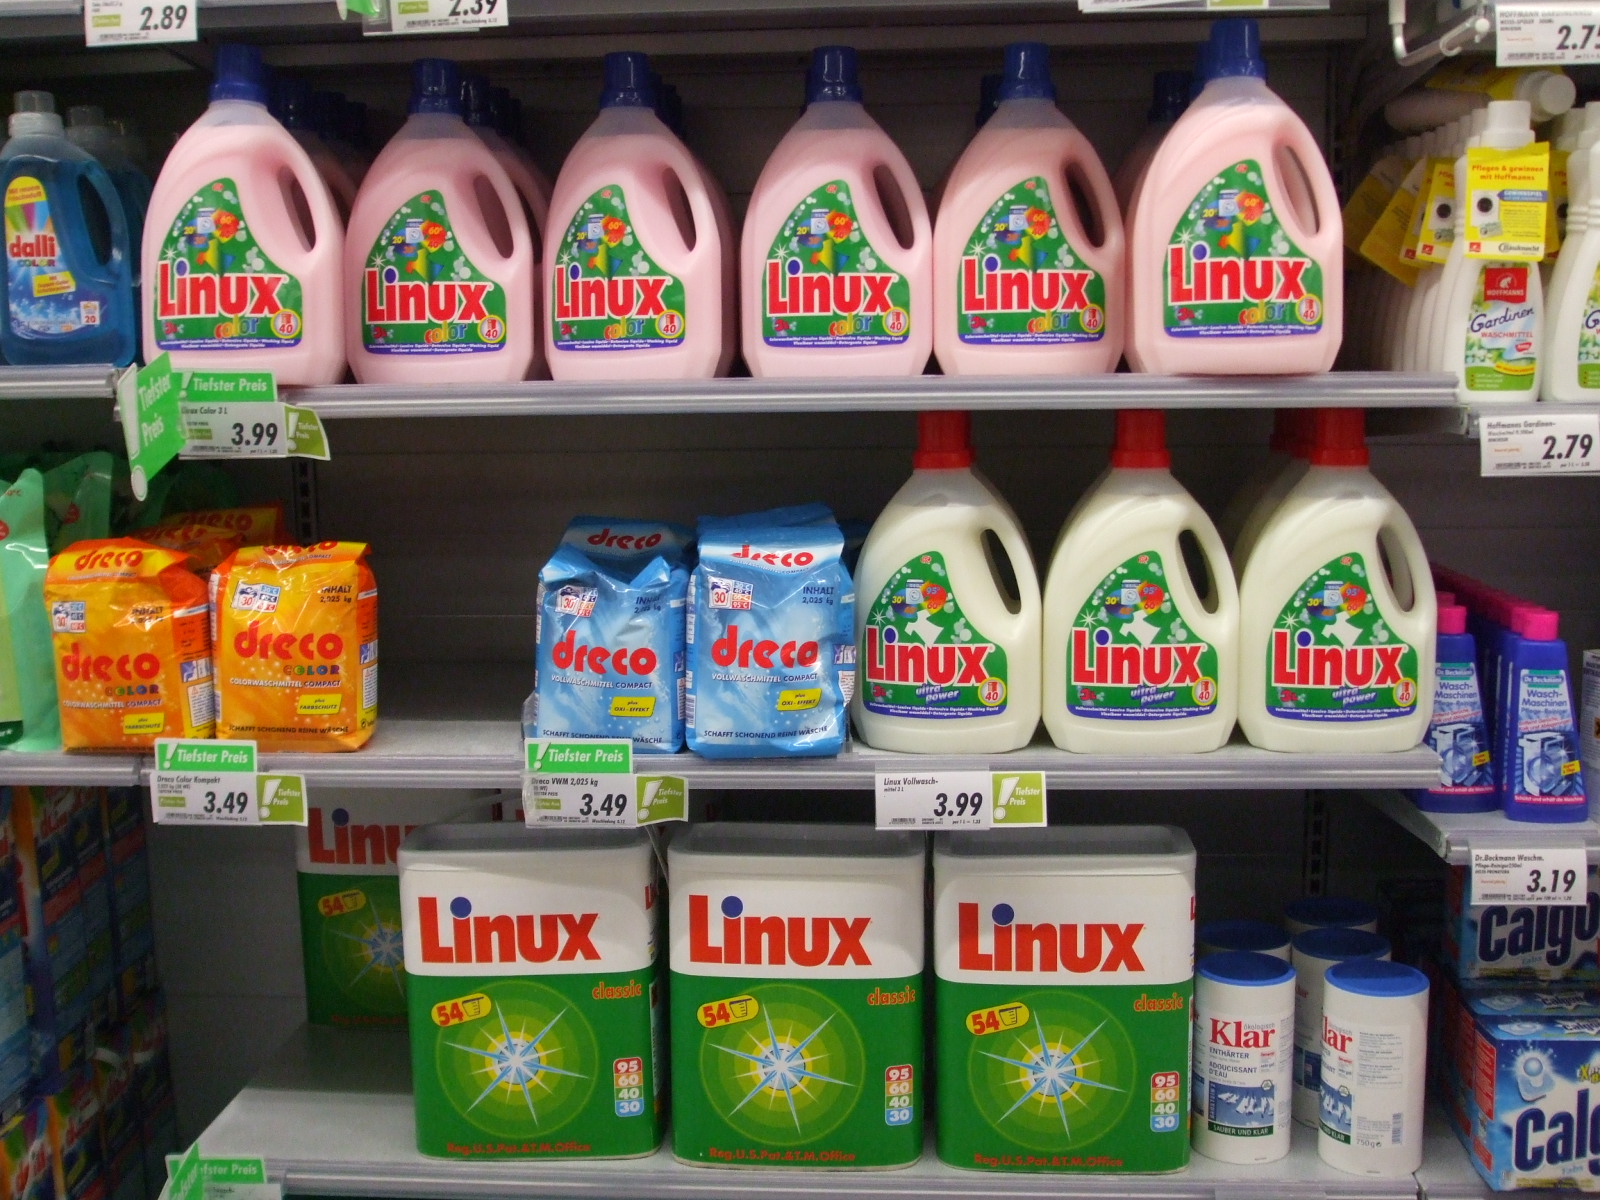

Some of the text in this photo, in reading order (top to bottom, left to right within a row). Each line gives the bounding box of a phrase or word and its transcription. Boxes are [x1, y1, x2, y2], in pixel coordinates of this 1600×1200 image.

[139, 5, 188, 31] 2.89
[1472, 165, 1499, 173] Pflegen
[9, 234, 56, 258] dalli
[17, 259, 56, 267] COLOR
[1170, 243, 1307, 303] Linux
[159, 259, 285, 318] Linux
[768, 259, 894, 315] Linux
[963, 256, 1090, 312] Linux
[367, 267, 490, 323] Linux
[556, 263, 668, 319] Linux
[1238, 300, 1285, 325] color
[1303, 311, 1315, 320] 40
[85, 316, 96, 324] 20
[214, 314, 260, 339] color
[829, 312, 873, 336] color
[889, 322, 902, 331] 40
[1027, 309, 1070, 333] color
[1087, 319, 1098, 328] 40
[1470, 307, 1535, 333] Gardinen
[279, 324, 293, 333] 40
[424, 320, 467, 344] color
[485, 329, 498, 339] 40
[604, 316, 645, 340] color
[663, 324, 677, 333] 40
[193, 377, 267, 392] Tiefster Preis
[138, 374, 171, 411] Tiefster
[142, 414, 164, 446] Preis
[231, 422, 278, 446] 3.99
[1542, 434, 1593, 460] 2.79
[587, 528, 662, 550] dreco
[74, 550, 143, 571] dreco
[730, 545, 813, 567] dreco
[714, 592, 726, 603] 30
[803, 587, 834, 595] INHALT
[241, 597, 252, 606] 30
[826, 597, 834, 605] kg
[234, 620, 344, 660] dreco
[711, 625, 819, 668] dreco
[552, 629, 657, 676] dreco
[866, 627, 990, 685] Linux
[1073, 629, 1203, 685] Linux
[1274, 630, 1404, 687] Linux
[62, 642, 160, 681] dreco
[283, 665, 340, 675] COLOR
[230, 678, 341, 688] COLORWASCHMITTEL COMPACT
[551, 675, 614, 689] VOLLWASCHMITTEL
[711, 673, 818, 683] VOLLWASCHMITTEL COMPACT
[105, 684, 159, 696] COLOR
[915, 684, 941, 696] ultra
[1130, 685, 1158, 697] ultra
[1332, 686, 1359, 698] ultra
[1439, 682, 1472, 690] Wasch-
[925, 689, 960, 703] power
[985, 691, 998, 700] 40
[1140, 690, 1175, 703] power
[1199, 692, 1210, 700] 40
[1342, 691, 1376, 705] power
[1399, 692, 1411, 701] 40
[1435, 691, 1477, 699] Maschinen
[1527, 690, 1563, 698] Wasch-
[63, 699, 162, 709] COLORWASCHMITTEL COMPACT
[1522, 698, 1567, 706] Maschinen
[257, 726, 297, 734] SCHONEND
[543, 730, 569, 738] SCHAFFT
[704, 726, 828, 739] SCHAFFT SCHONEND REINE WÄSCHE
[177, 749, 248, 763] Tiefster Preis
[549, 749, 623, 763] Tiefster Preis
[194, 776, 220, 785] Kompakt
[571, 778, 588, 786] 2,025
[590, 778, 598, 787] kg
[884, 777, 938, 785] Linux Vollwasch-
[278, 788, 300, 797] Tiefster
[658, 788, 682, 796] Tiefster
[1015, 788, 1040, 796] Tiefster
[203, 791, 248, 814] 3.49
[580, 793, 627, 816] 3.49
[652, 797, 667, 805] Preis
[934, 792, 983, 817] 3.99
[1010, 798, 1026, 806] Preis
[308, 808, 422, 865] Linu
[1527, 870, 1576, 892] 3.19
[322, 897, 344, 916] 54
[418, 896, 602, 963] Linux
[689, 894, 872, 966] Linux
[959, 902, 1145, 973] Linux
[592, 980, 642, 999] classic
[867, 986, 915, 1005] classic
[1134, 992, 1183, 1012] classic
[436, 1002, 464, 1026] 54
[703, 1002, 730, 1026] 54
[972, 1010, 1000, 1035] 54
[1244, 1023, 1275, 1031] ökologisch
[1209, 1018, 1275, 1048] Klar
[1322, 1016, 1353, 1053] lar
[1209, 1047, 1249, 1058] ENTHÄRTER
[616, 1060, 639, 1073] 95
[1209, 1061, 1257, 1073] ADOUCISSANT
[618, 1074, 639, 1086] 60
[889, 1069, 910, 1080] 95
[1155, 1075, 1176, 1087] 95
[618, 1088, 640, 1099] 40
[889, 1082, 910, 1094] 60
[889, 1096, 910, 1107] 40
[1155, 1089, 1175, 1101] 60
[619, 1101, 640, 1112] 30
[1154, 1103, 1175, 1114] 40
[889, 1110, 910, 1121] 30
[1154, 1116, 1175, 1128] 30
[1214, 1125, 1268, 1136] SAUBER UND KLAR
[232, 1163, 257, 1175] Preis
